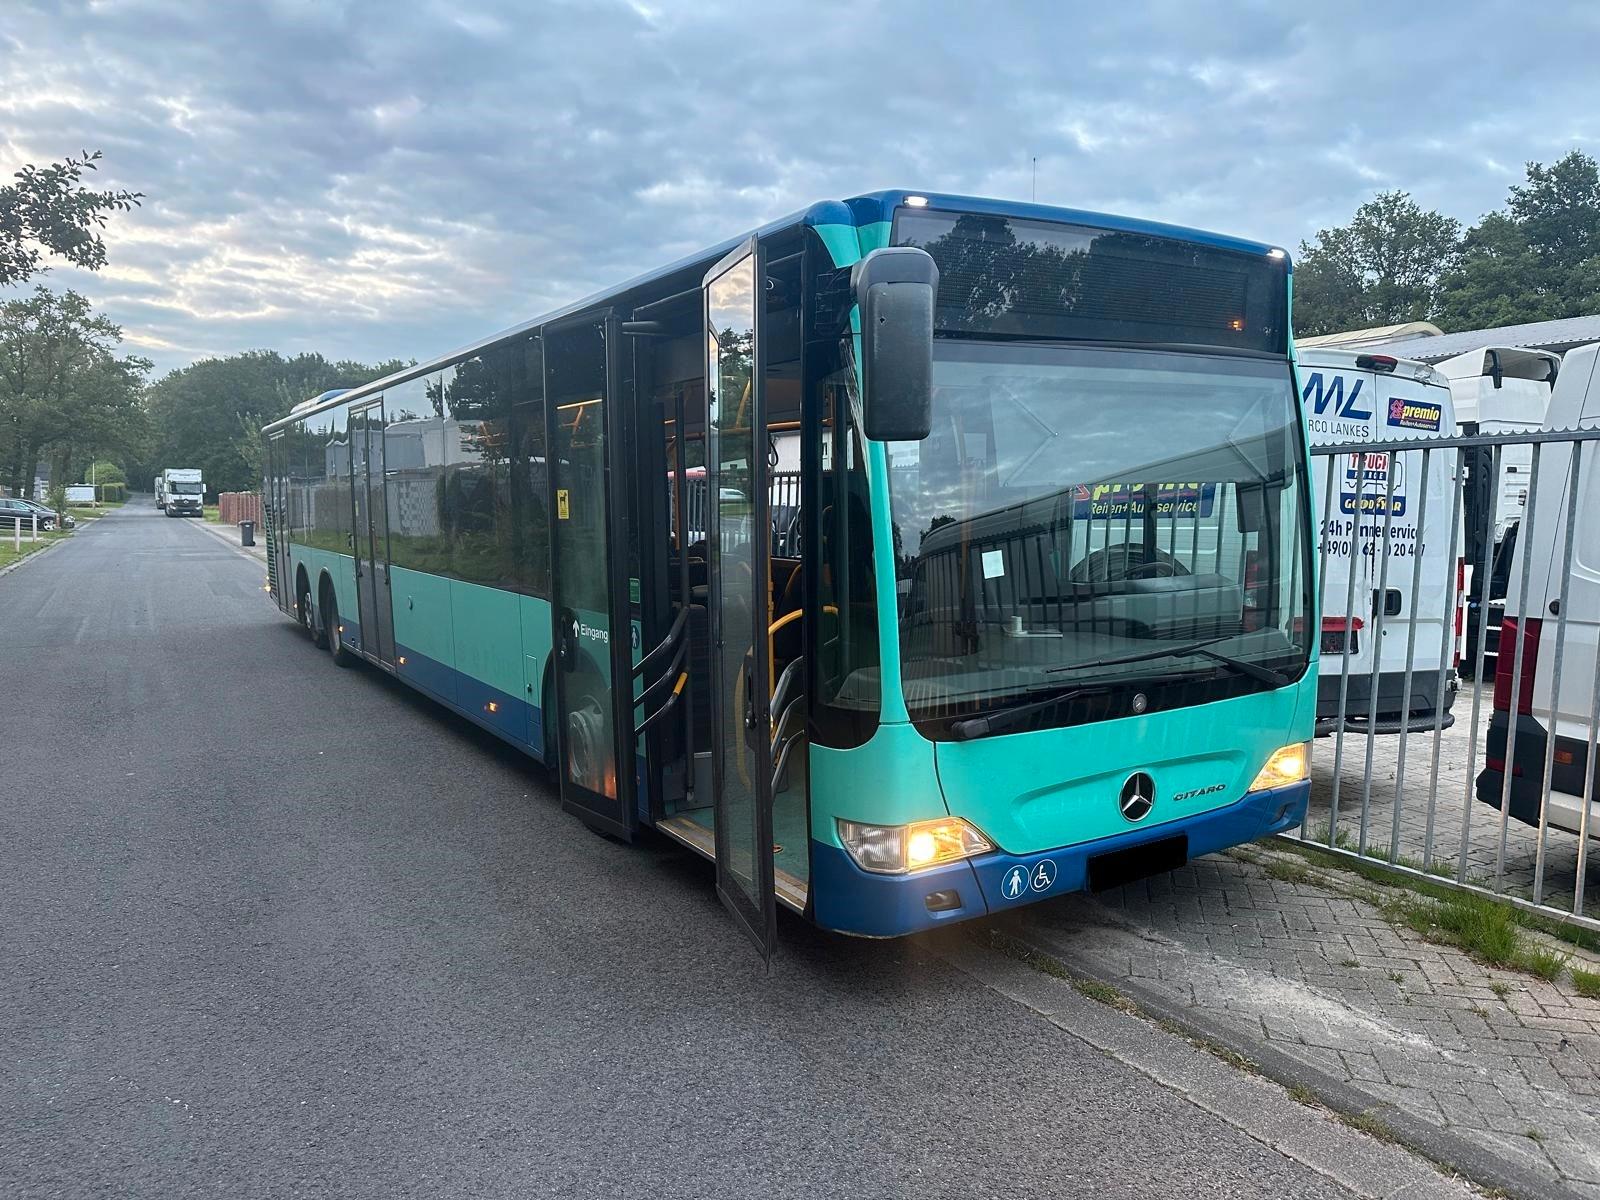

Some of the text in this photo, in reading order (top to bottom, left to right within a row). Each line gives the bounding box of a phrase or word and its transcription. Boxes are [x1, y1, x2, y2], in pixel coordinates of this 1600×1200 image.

[1401, 405, 1440, 421] premio
[1308, 419, 1370, 438] RCO LANKES
[580, 623, 609, 644] Eingang
[1173, 783, 1226, 801] CITARO
